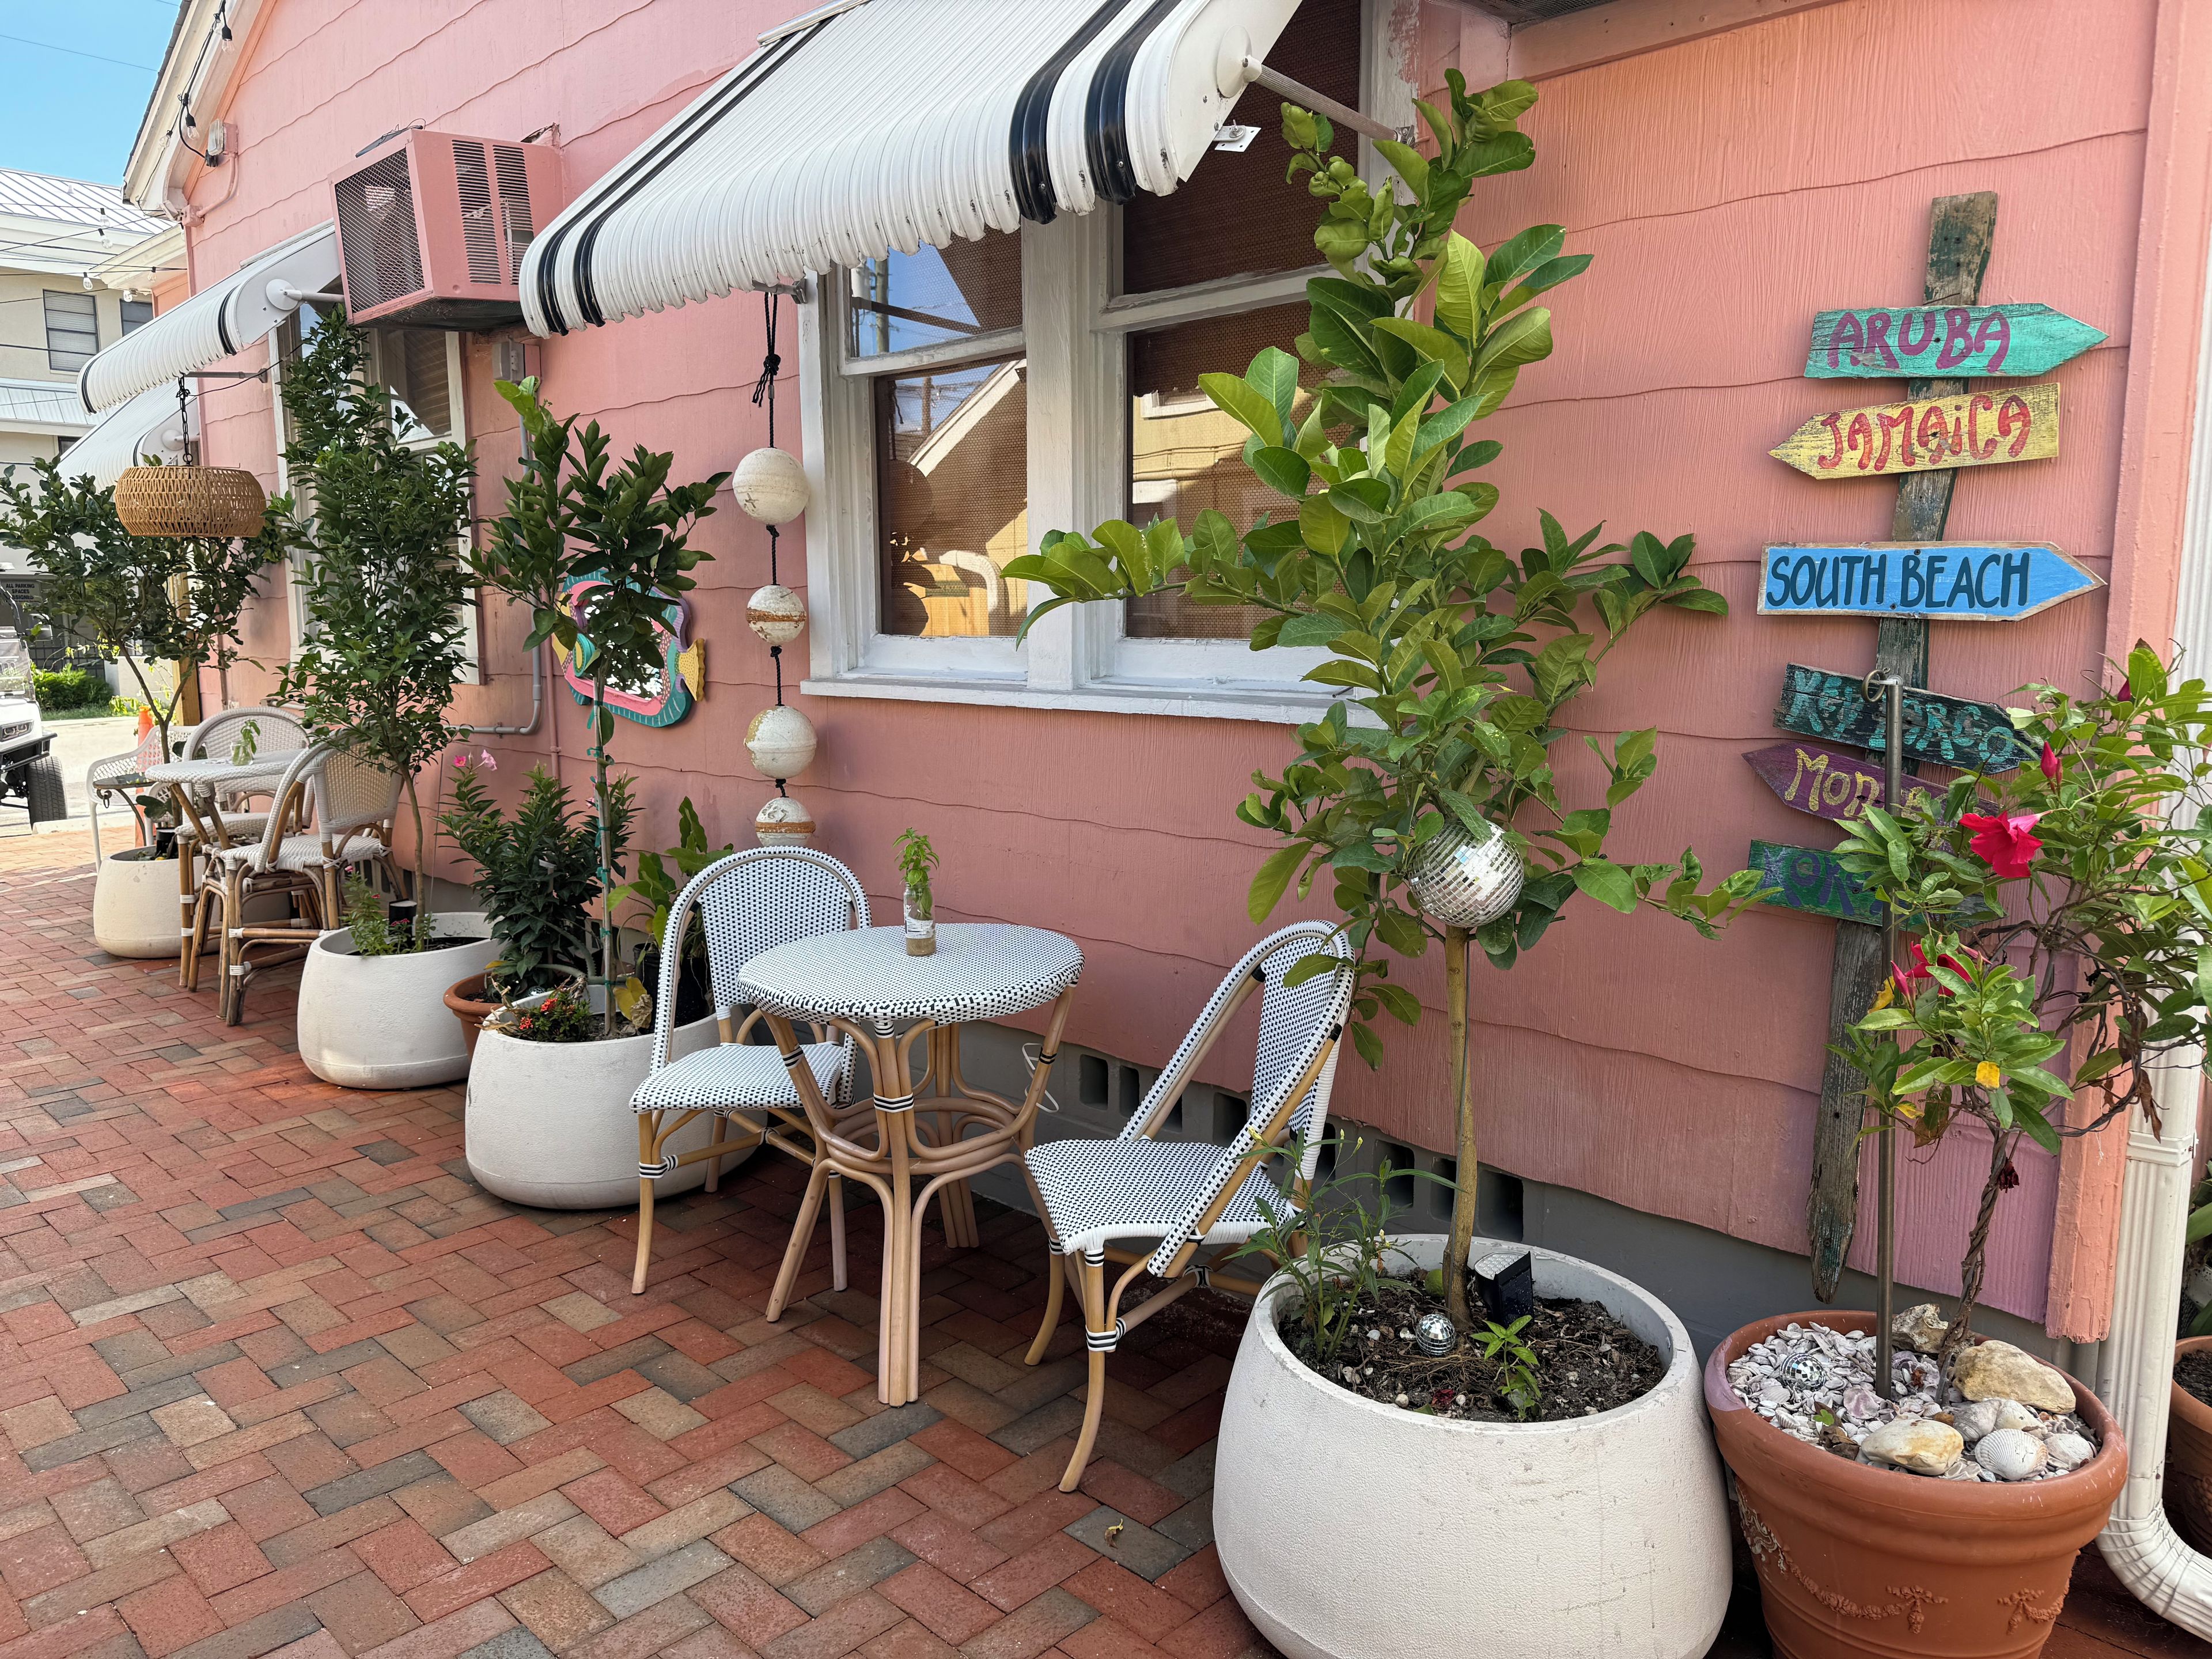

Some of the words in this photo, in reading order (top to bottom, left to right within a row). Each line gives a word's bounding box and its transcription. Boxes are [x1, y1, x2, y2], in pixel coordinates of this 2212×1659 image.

[1827, 308, 2011, 373] ARUBA
[1766, 554, 1887, 608] SOUTH
[1900, 551, 2032, 609] BEACH
